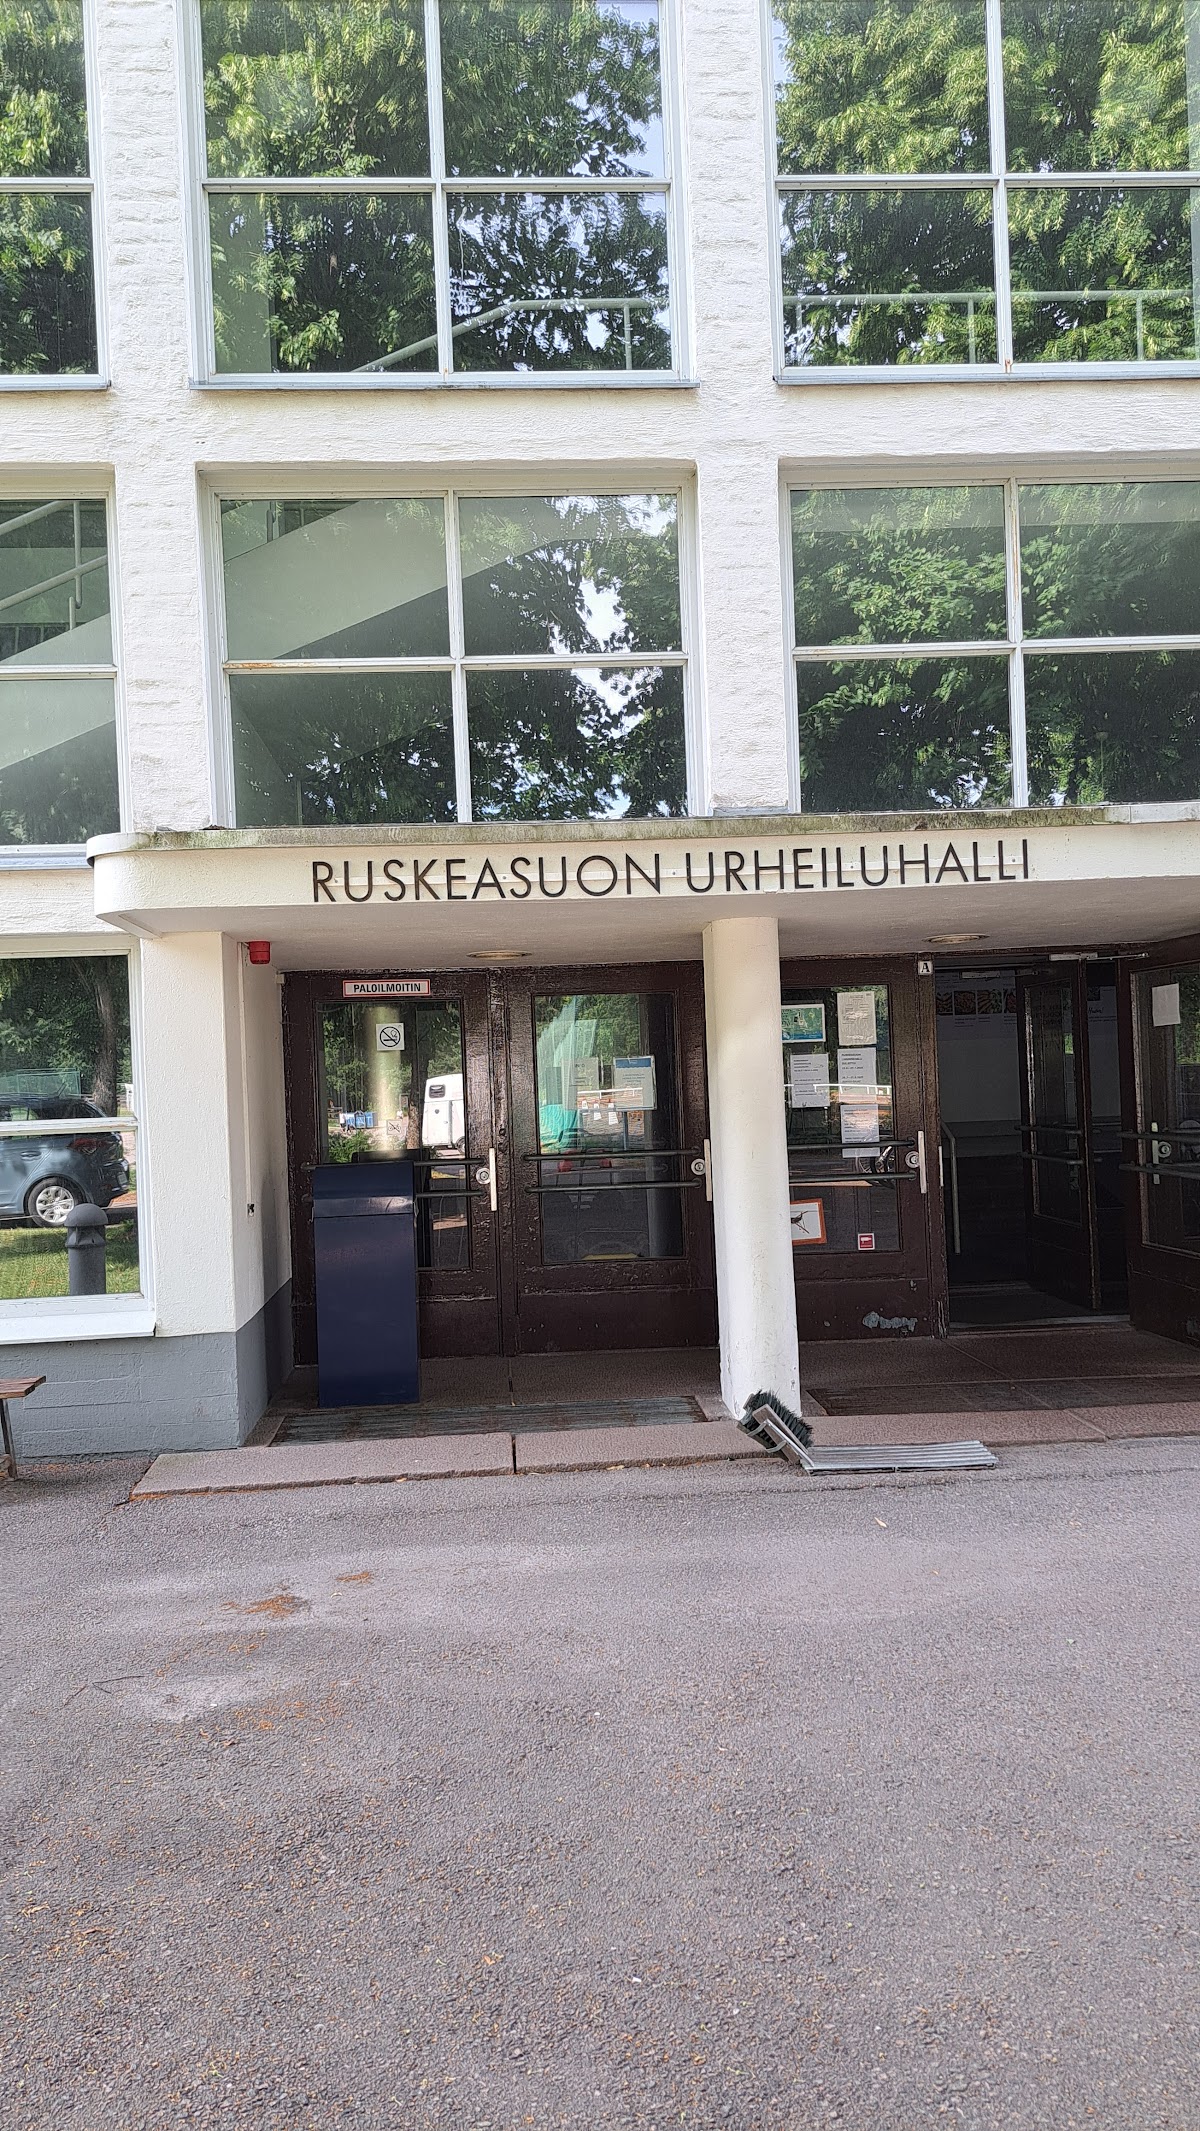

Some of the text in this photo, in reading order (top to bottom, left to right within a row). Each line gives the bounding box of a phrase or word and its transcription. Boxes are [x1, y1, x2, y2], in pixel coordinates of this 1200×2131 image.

[312, 839, 1029, 902] RUSKEASUON URHEILUHALLI
[353, 983, 421, 993] PALOILMOITIN
